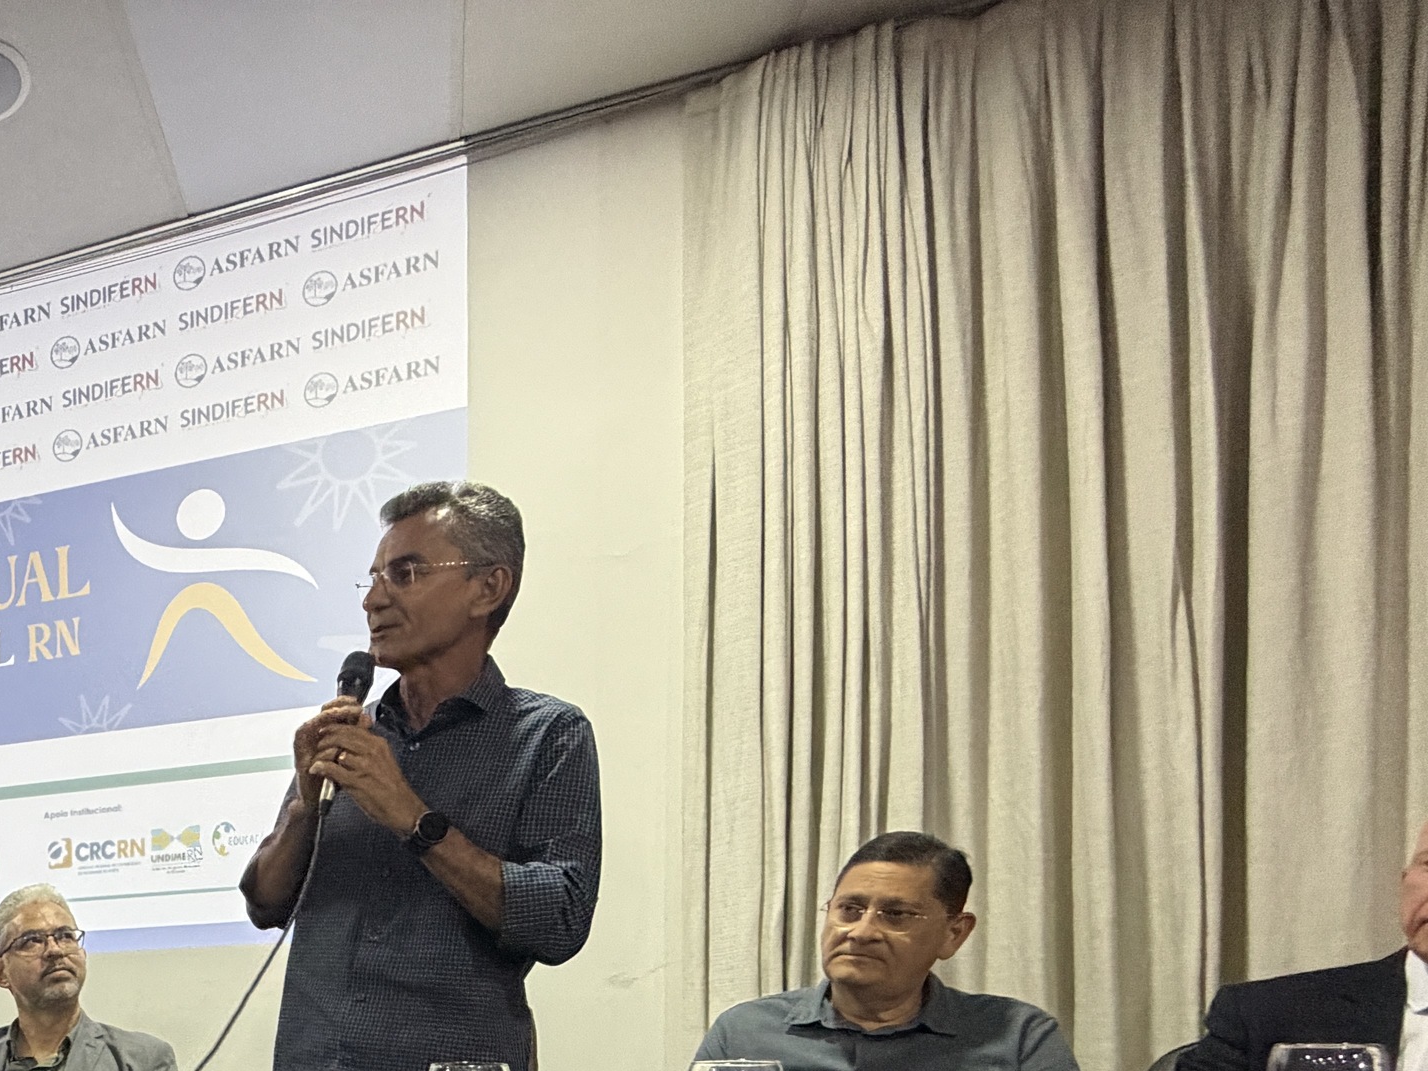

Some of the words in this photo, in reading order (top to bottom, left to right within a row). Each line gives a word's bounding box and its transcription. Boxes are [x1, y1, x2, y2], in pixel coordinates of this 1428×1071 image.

[60, 272, 157, 314] SINDIFERN
[209, 235, 300, 276] ASFARN
[311, 200, 425, 248] SINDIFERN
[84, 319, 166, 355] ASFARN
[178, 288, 283, 331] SINDIFERN
[342, 250, 440, 291] ASFARN
[62, 369, 159, 408] SINDIFERN
[211, 337, 301, 374] ASFARN
[311, 306, 426, 350] SINDIFERN
[86, 415, 169, 450] ASFARN
[180, 389, 284, 428] SINDIFERN
[342, 355, 440, 394] ASFARN
[27, 618, 82, 663] RN
[75, 837, 145, 862] CRCRN
